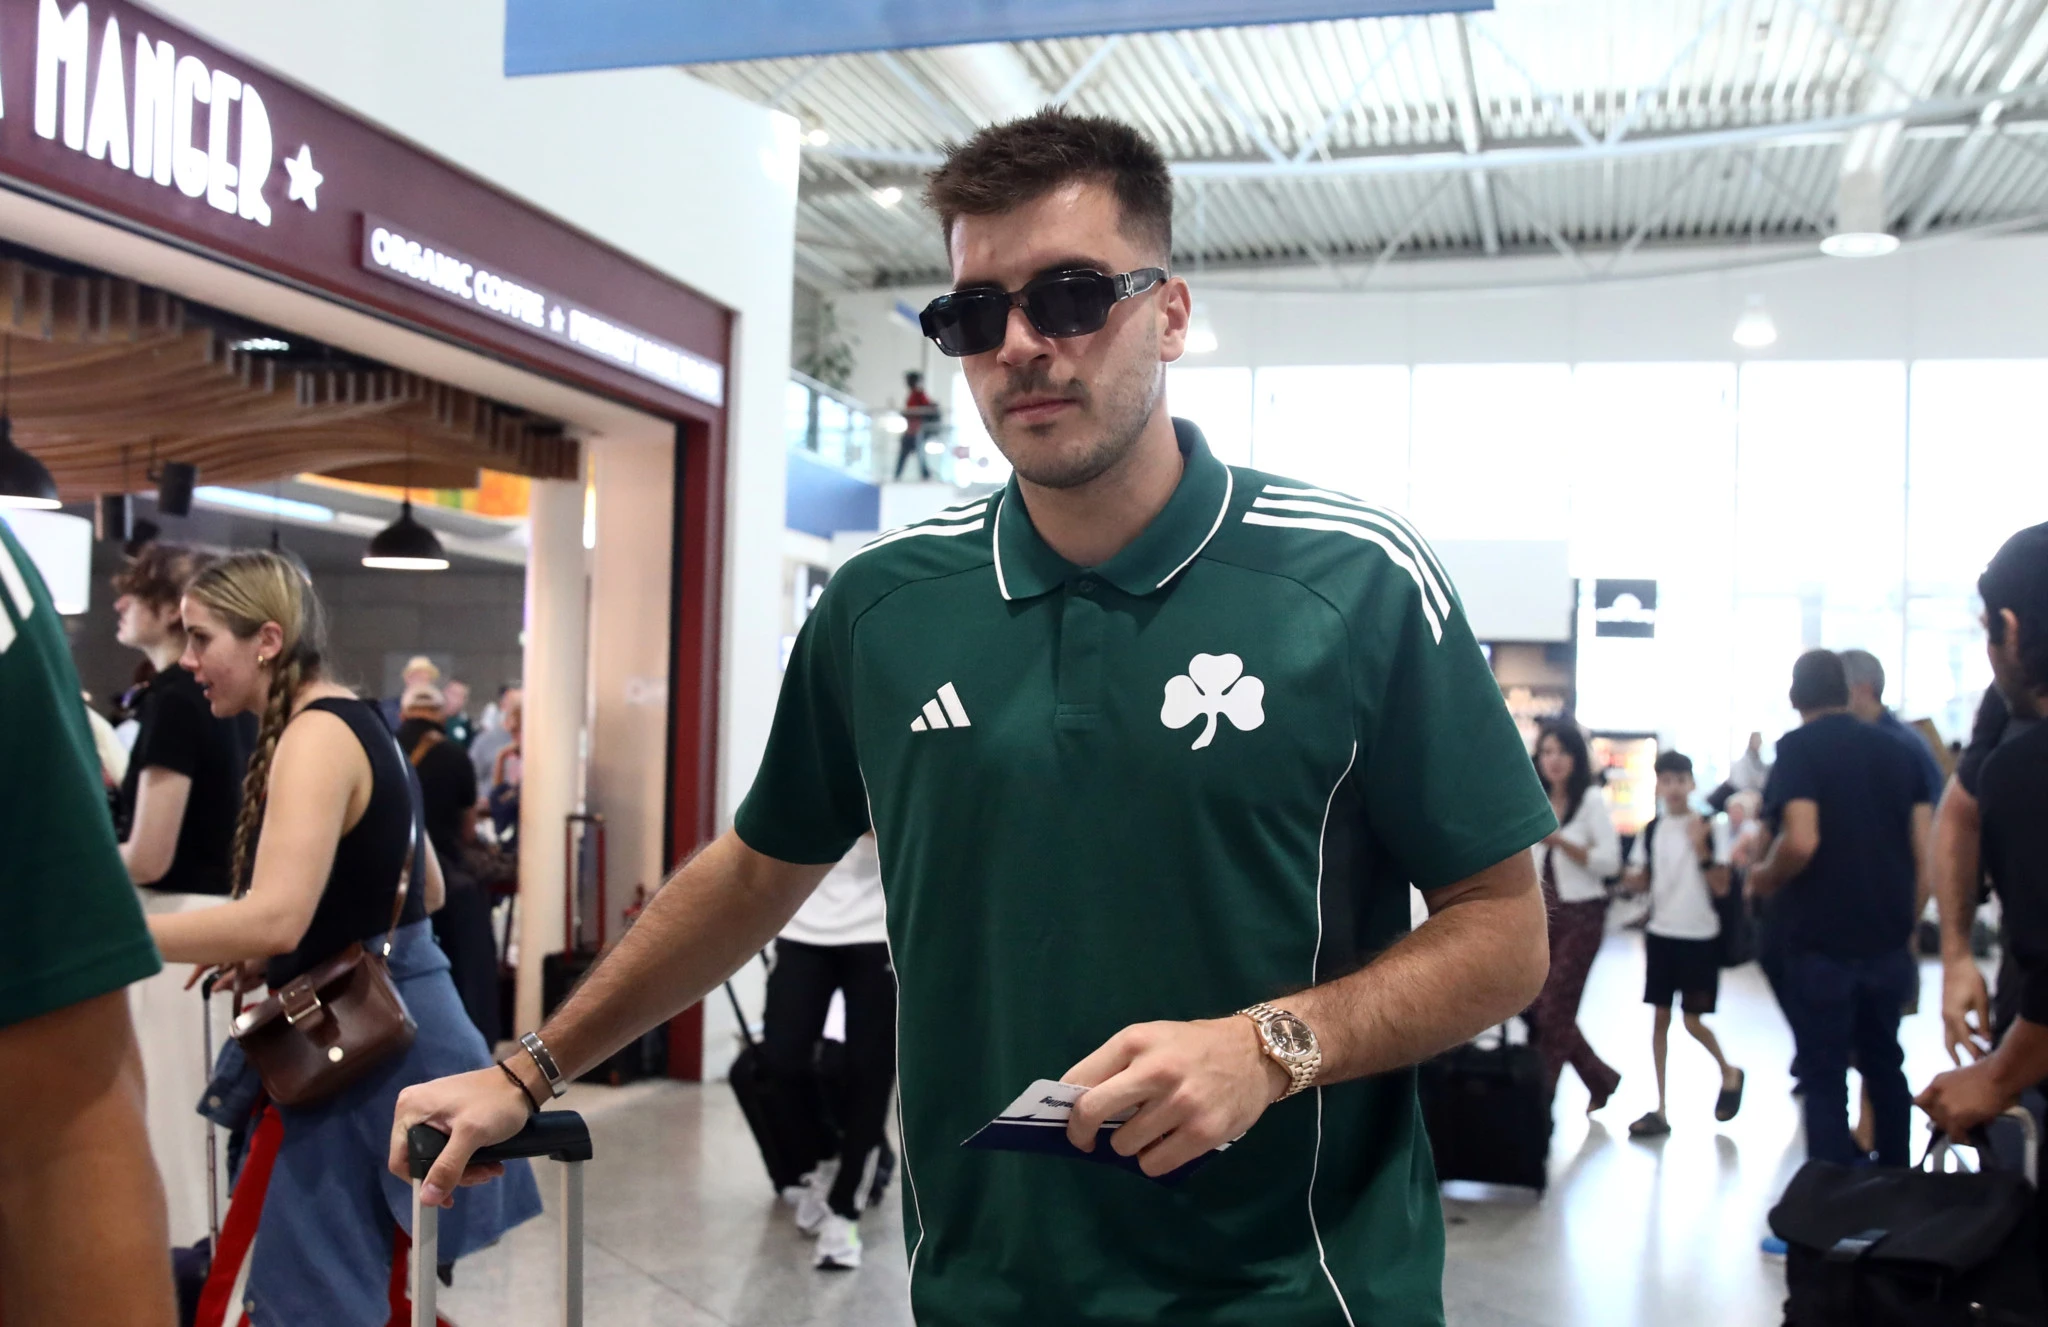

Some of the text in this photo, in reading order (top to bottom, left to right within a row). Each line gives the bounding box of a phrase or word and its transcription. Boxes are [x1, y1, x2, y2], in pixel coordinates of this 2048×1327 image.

[34, 0, 273, 227] MANGER
[371, 227, 545, 328] ORGANIC COFFEE
